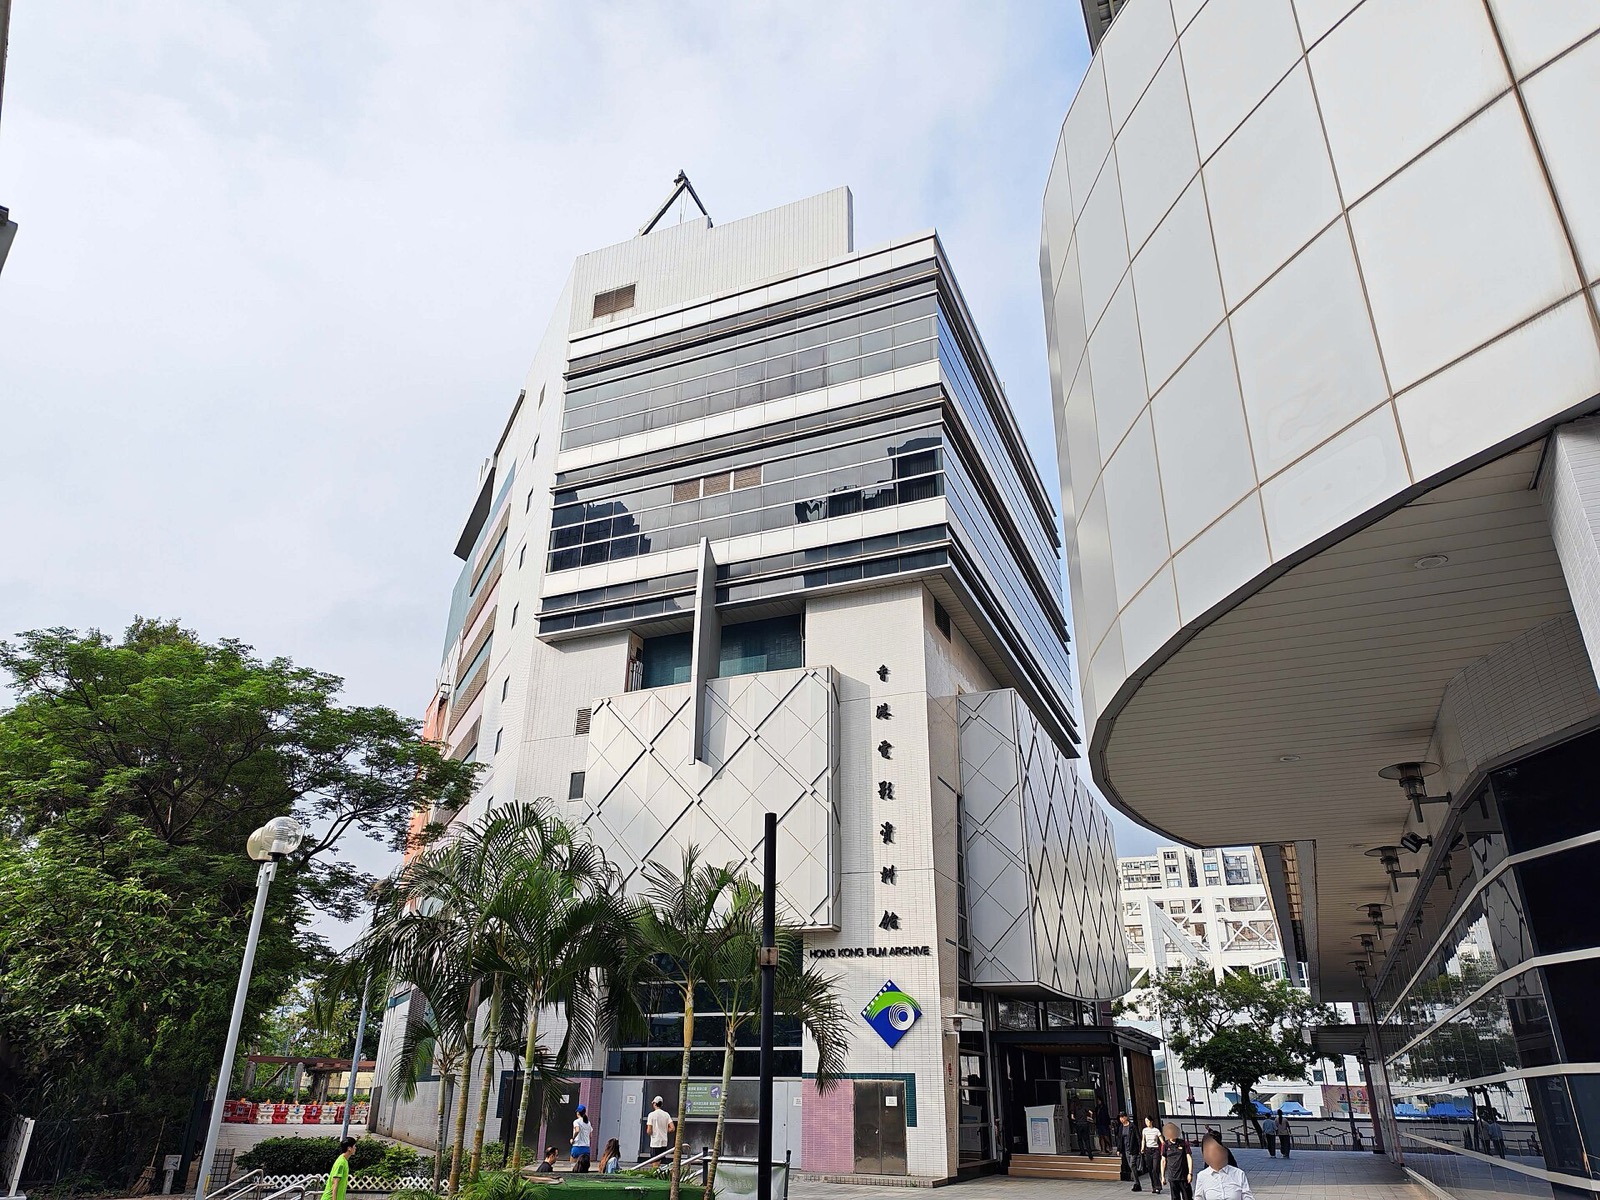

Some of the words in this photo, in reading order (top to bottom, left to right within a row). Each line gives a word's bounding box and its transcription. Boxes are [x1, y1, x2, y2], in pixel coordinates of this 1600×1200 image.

[809, 949, 836, 959] HONG
[838, 948, 864, 958] KONG
[866, 947, 887, 957] FILM
[889, 946, 930, 956] ARCHIVE
